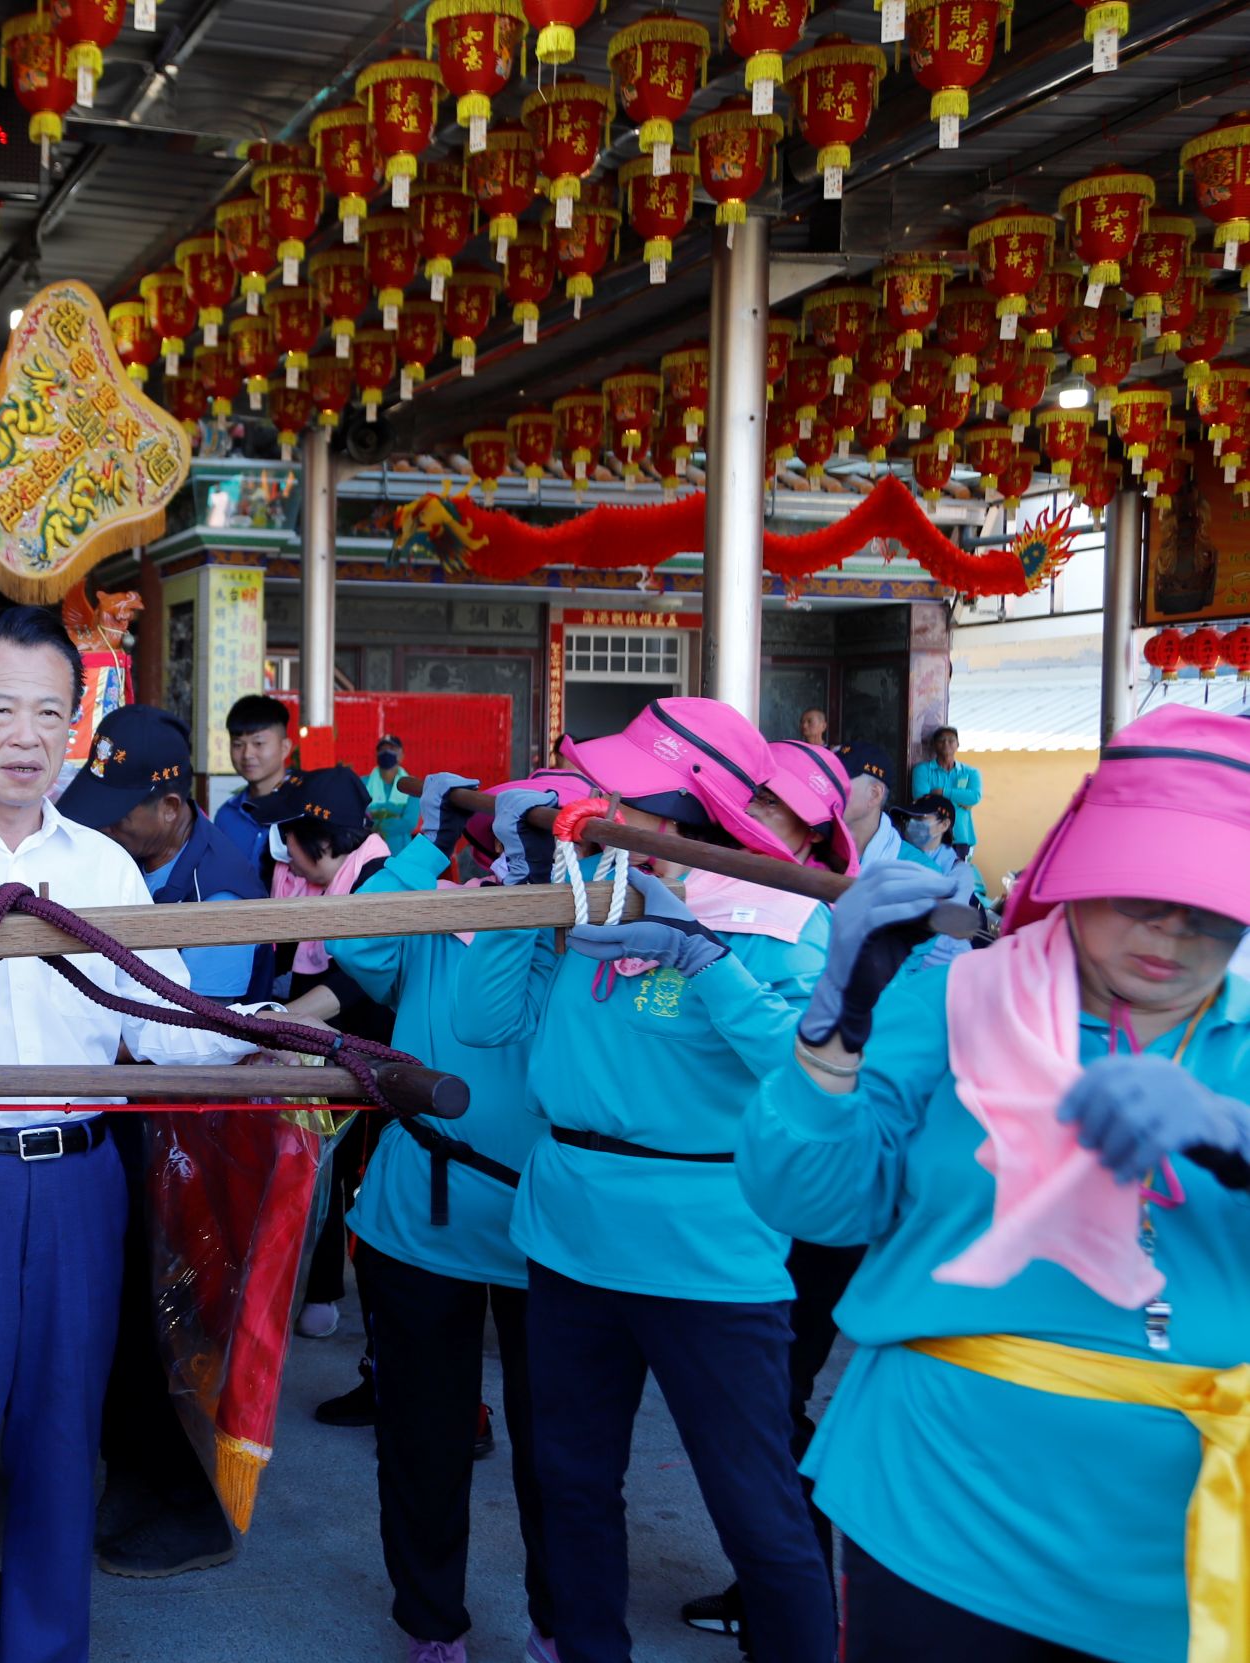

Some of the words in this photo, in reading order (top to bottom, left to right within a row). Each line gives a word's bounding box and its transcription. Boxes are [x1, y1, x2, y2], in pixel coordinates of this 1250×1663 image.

[947, 5, 971, 53] 財源
[966, 18, 989, 66] 廣進
[461, 26, 484, 73] 如意
[650, 43, 669, 87] 財源
[667, 57, 687, 101] 廣進
[816, 68, 837, 112] 財源
[385, 83, 403, 124] 財源
[836, 79, 858, 123] 廣進
[556, 103, 573, 143] 吉祥
[659, 181, 679, 220] 廣進
[1091, 196, 1111, 233] 吉祥
[1109, 204, 1131, 244] 如意
[1004, 234, 1022, 269] 吉祥
[1021, 243, 1039, 280] 如意
[1138, 236, 1158, 269] 吉祥
[1155, 243, 1175, 280] 如意
[150, 764, 179, 783] 太聖宮
